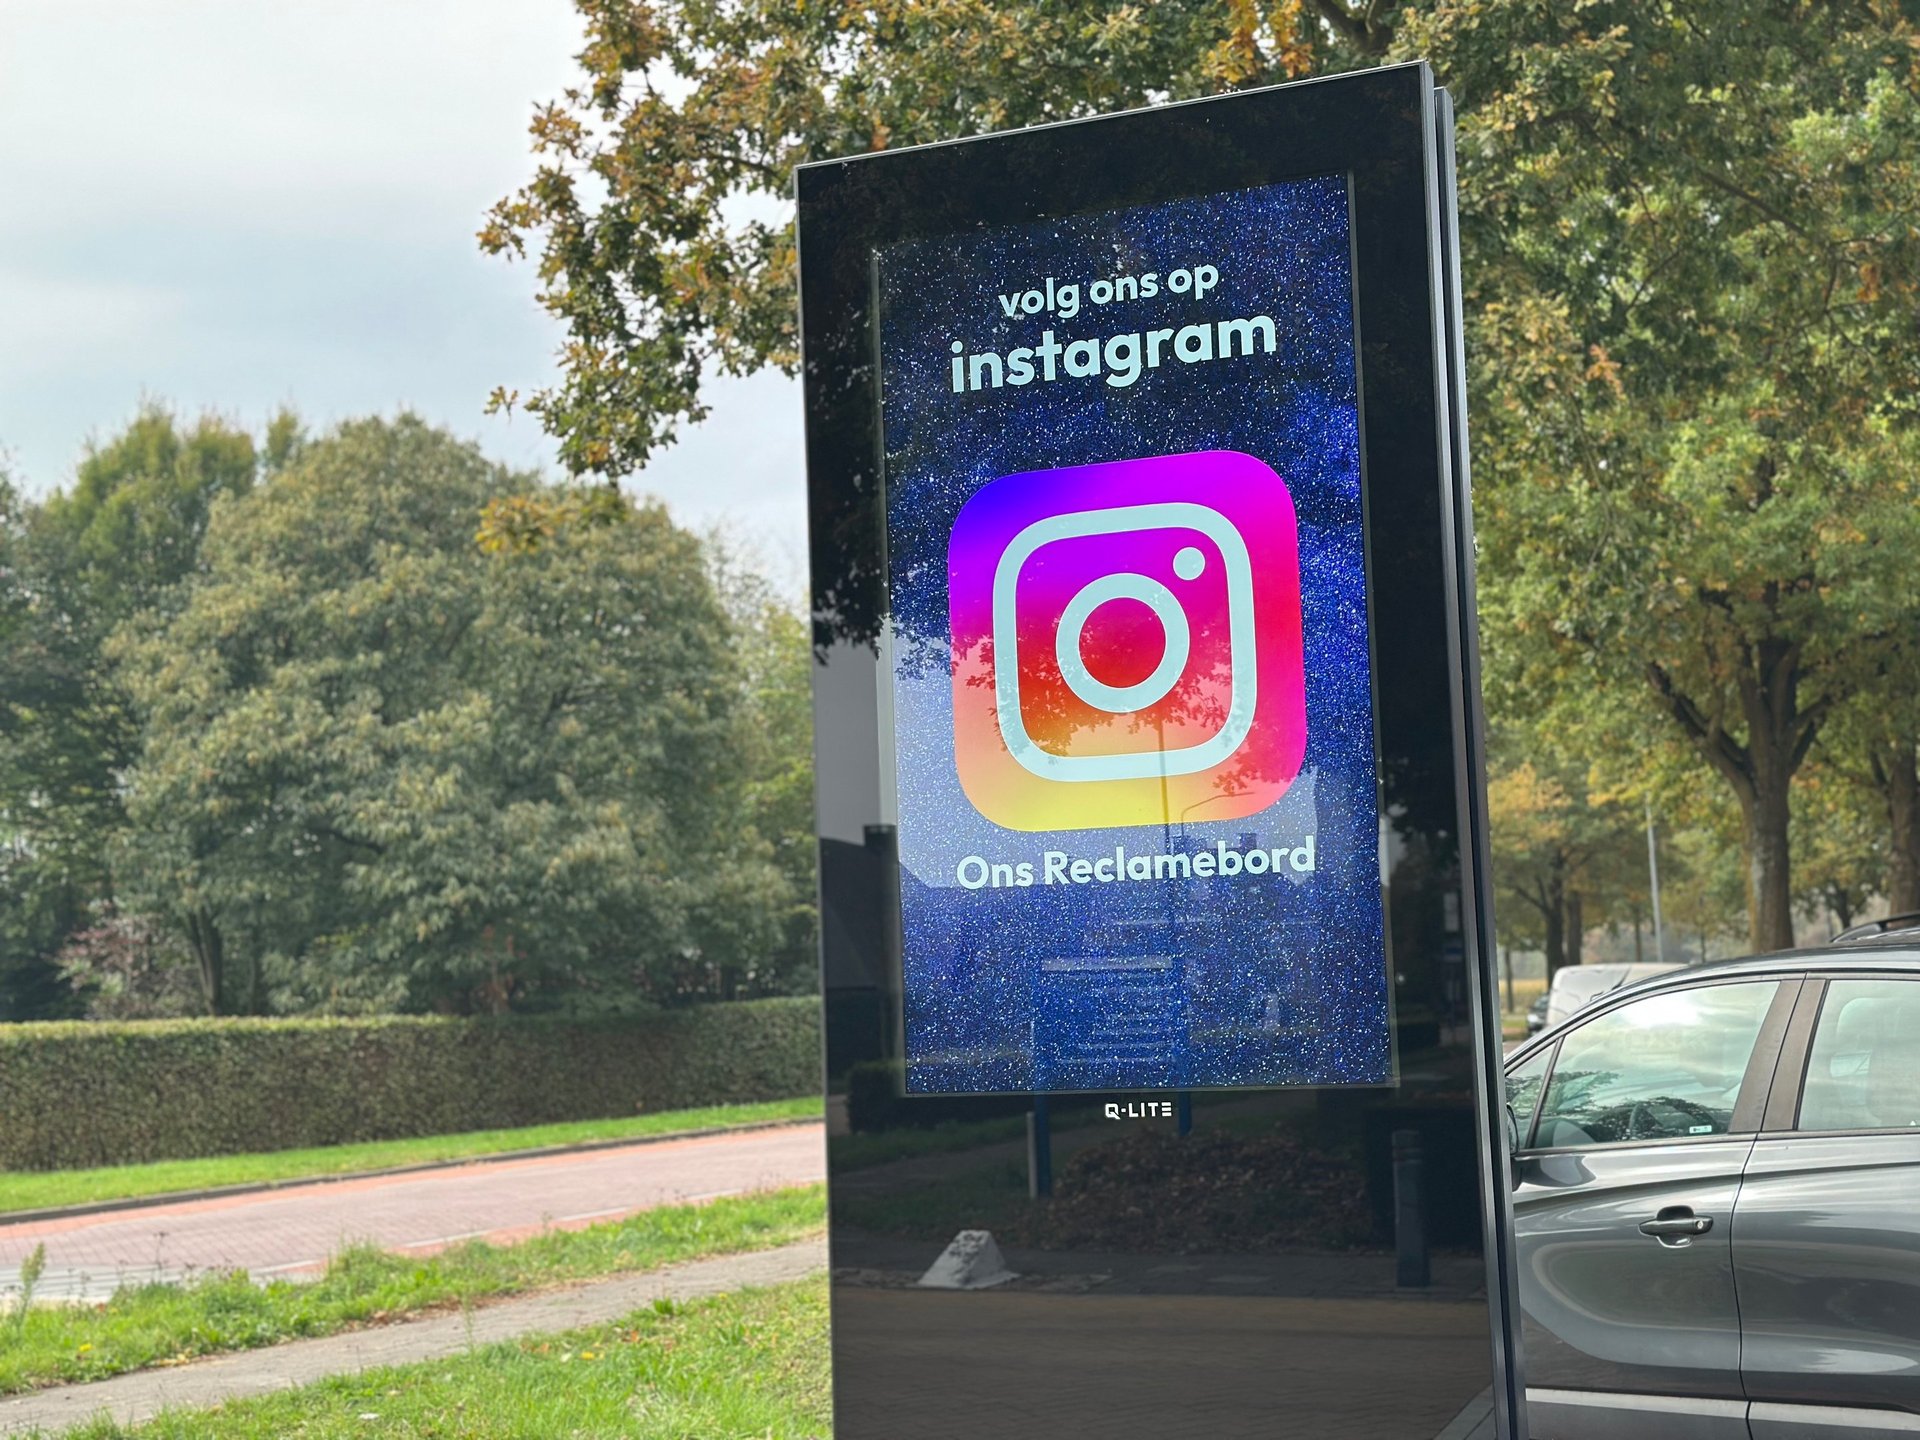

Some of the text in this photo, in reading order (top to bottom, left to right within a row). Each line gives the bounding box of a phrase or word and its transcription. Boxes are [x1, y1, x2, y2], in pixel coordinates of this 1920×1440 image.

[999, 264, 1219, 318] volg ons op
[951, 315, 1277, 393] instagram
[956, 835, 1316, 890] Ons Reclamebord
